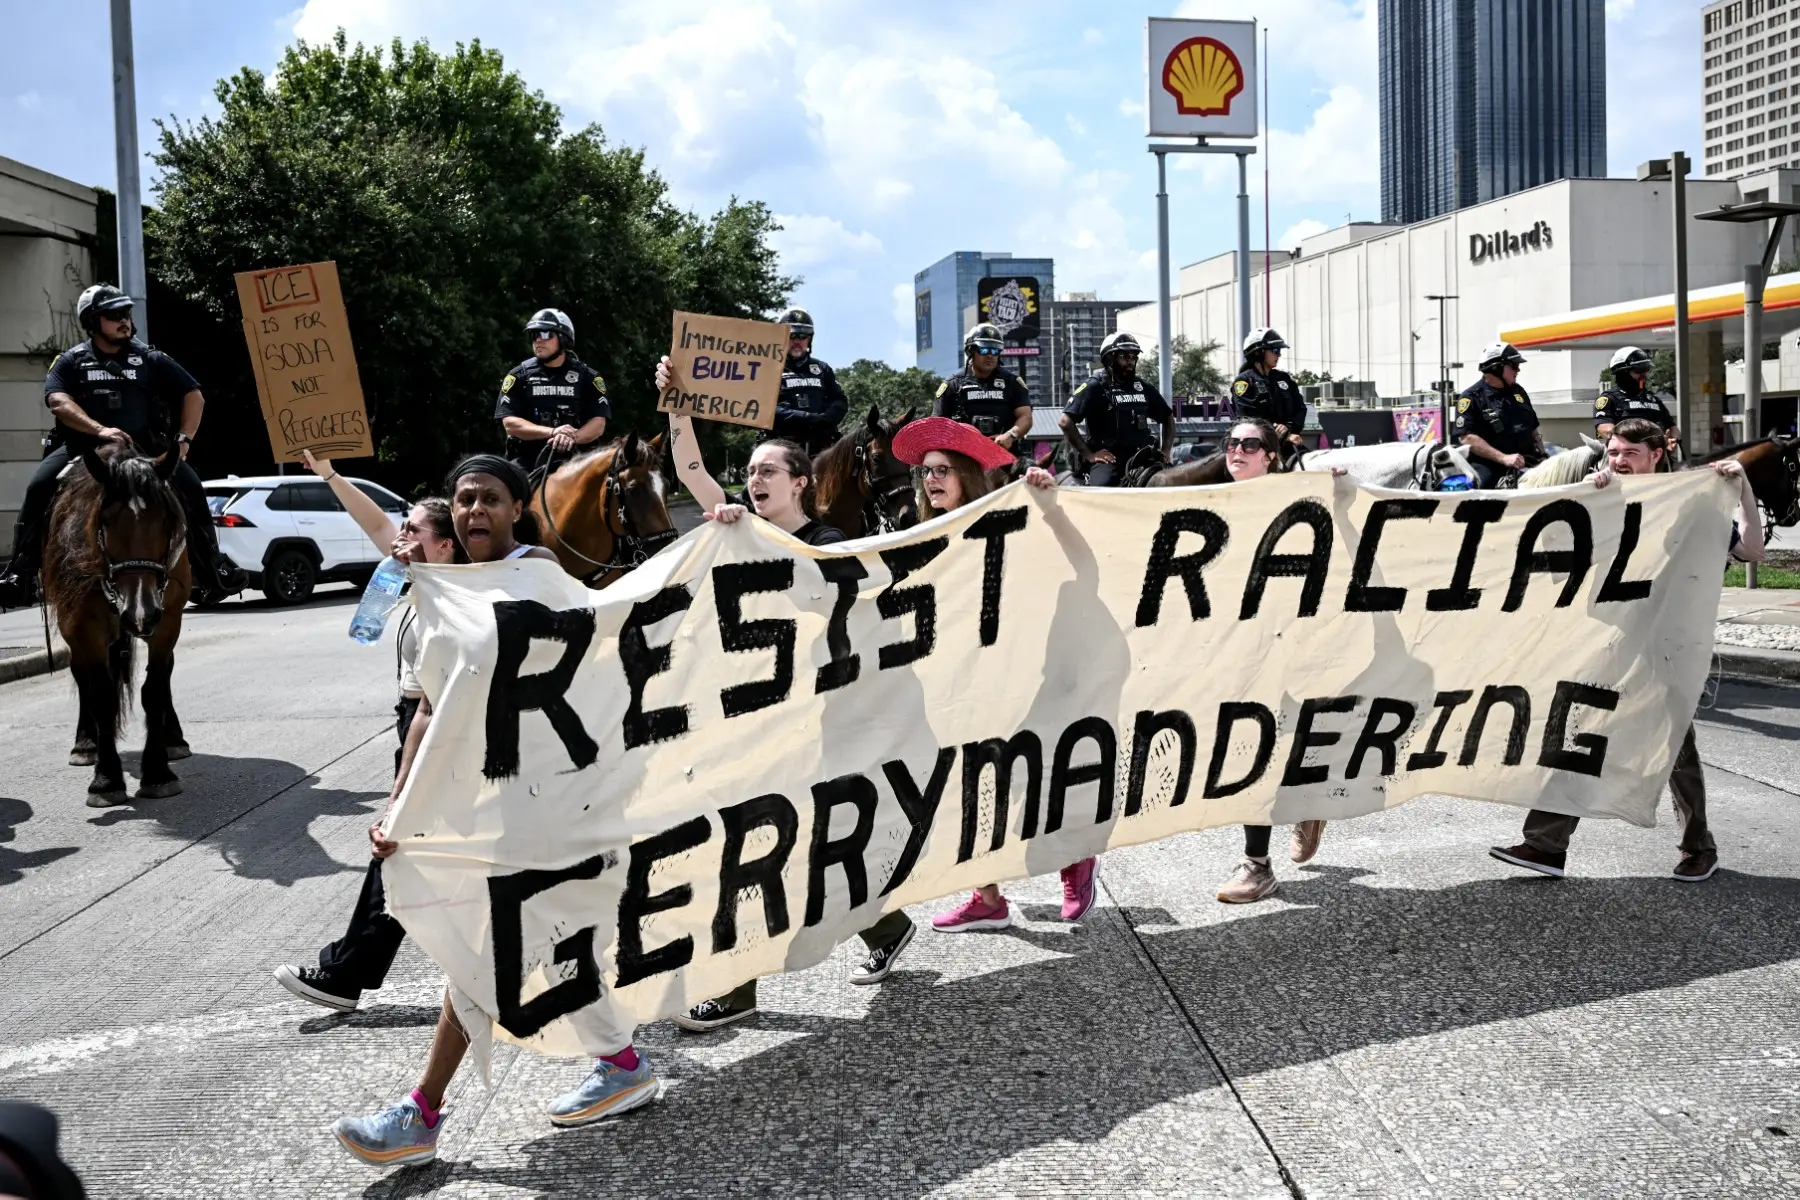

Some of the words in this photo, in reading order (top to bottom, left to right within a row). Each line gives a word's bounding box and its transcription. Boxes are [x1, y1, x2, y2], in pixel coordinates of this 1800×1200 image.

[1469, 220, 1552, 262] Dillard's
[259, 271, 310, 306] ICE
[262, 317, 279, 334] IS
[295, 311, 327, 330] FOR
[998, 304, 1017, 320] TACO
[265, 338, 334, 371] SODA
[680, 321, 784, 363] IMMIGRANTS
[291, 375, 323, 395] NOT
[692, 356, 763, 381] BUILT
[532, 385, 557, 396] HOUSTON
[556, 385, 575, 396] POLICE
[662, 387, 760, 420] AMERICA
[278, 408, 365, 446] REFUGEES
[483, 505, 1028, 781] RESIST
[1135, 496, 1653, 627] RACIAL
[488, 680, 1621, 1038] GERRYMANDERING
